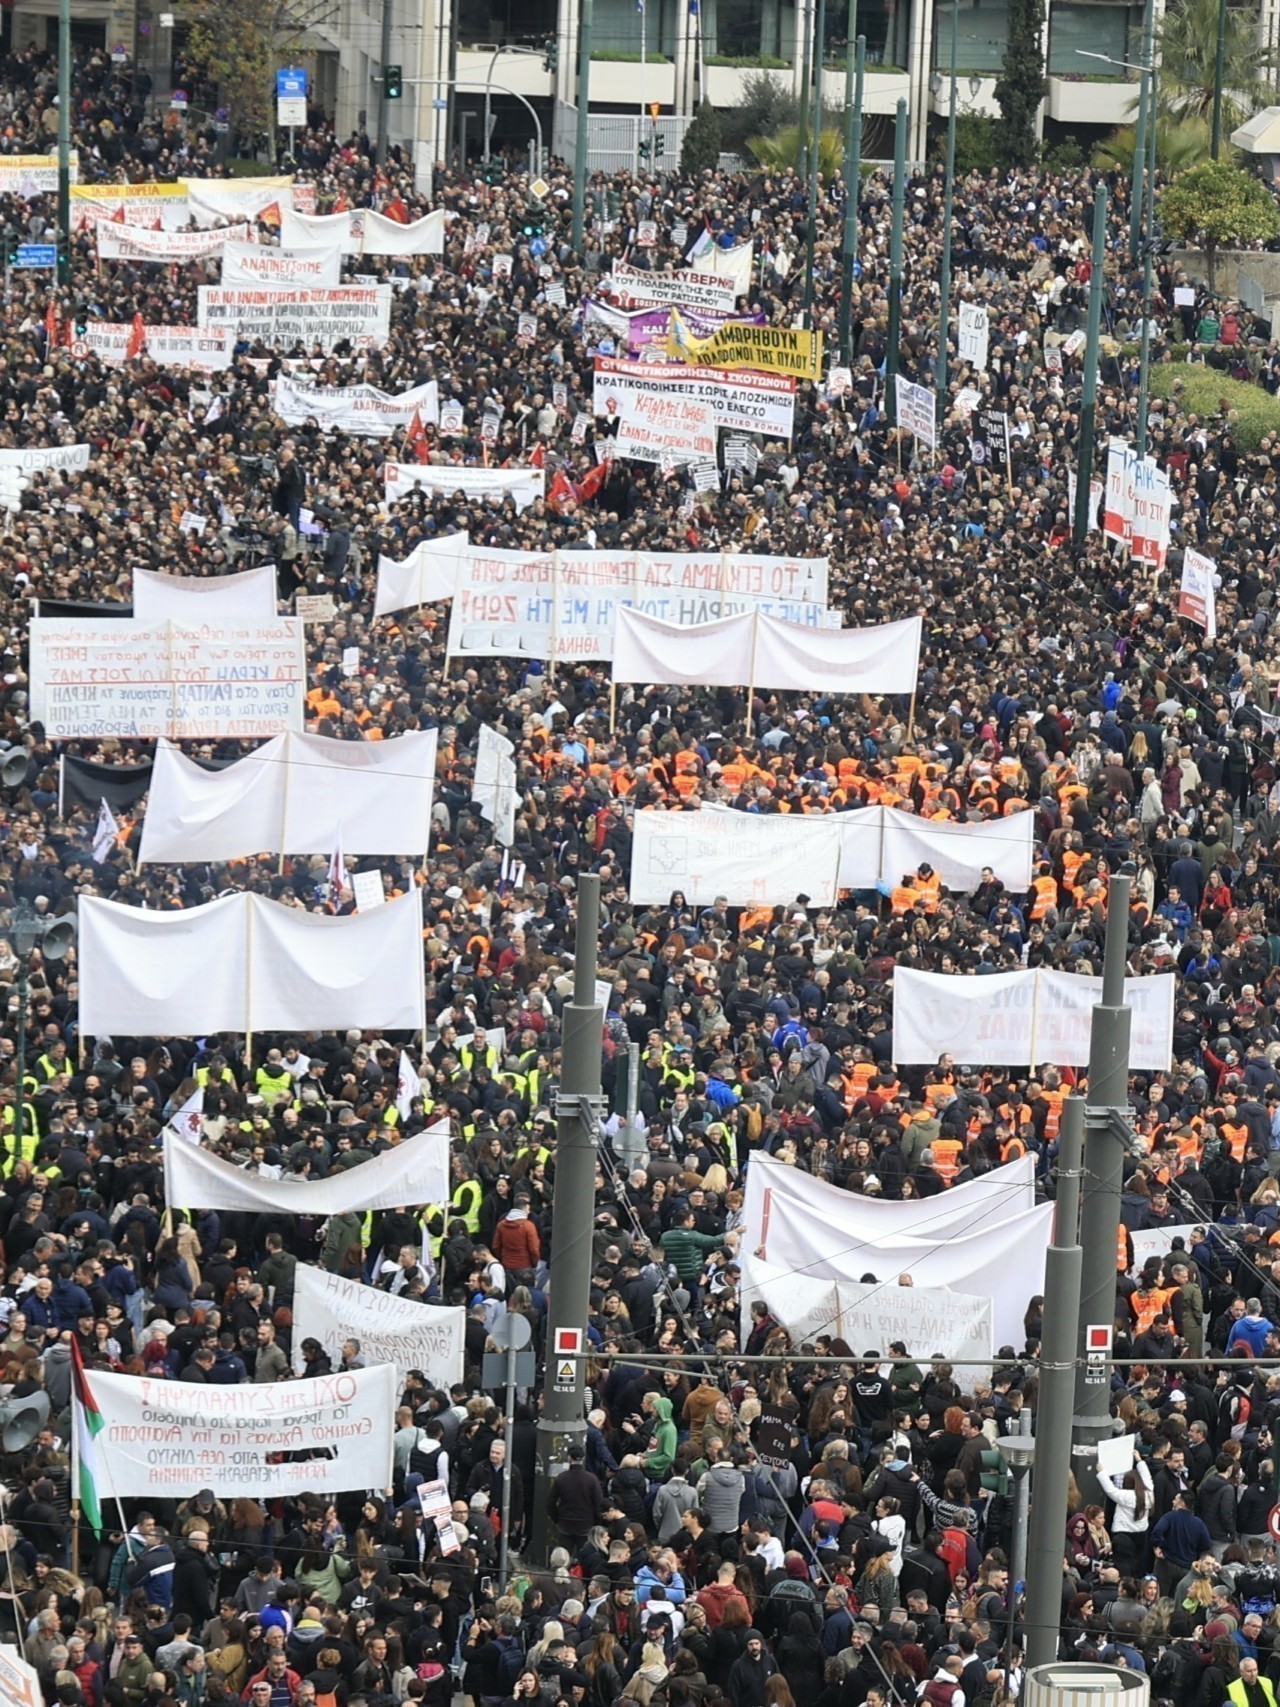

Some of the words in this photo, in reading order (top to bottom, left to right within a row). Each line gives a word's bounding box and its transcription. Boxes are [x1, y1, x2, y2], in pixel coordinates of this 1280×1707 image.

[125, 186, 160, 196] ΠΟΡΕΙΑ
[240, 257, 322, 274] ΑΝΑΠΝΕΥΣΟΥΜΕ
[614, 277, 632, 286] ΤΟΥ
[652, 289, 668, 299] ΤΟΥ
[756, 351, 774, 365] ΤΗΣ
[776, 354, 808, 370] ΠΥΛΟΥ
[727, 372, 791, 390] ΣΚΟΤΩΝΟΥΝ
[596, 376, 695, 395] ΚΡΑΤΙΚΟΠΟΙΗΣΕΙΣ
[699, 386, 729, 398] ΧΩΡΙΣ
[731, 391, 792, 408] ΑΠΟΖΗΜΙΩΣΗ
[727, 402, 767, 417] ΕΛΕΓΧΟ
[756, 420, 785, 433] ΚΟΜΜΑ
